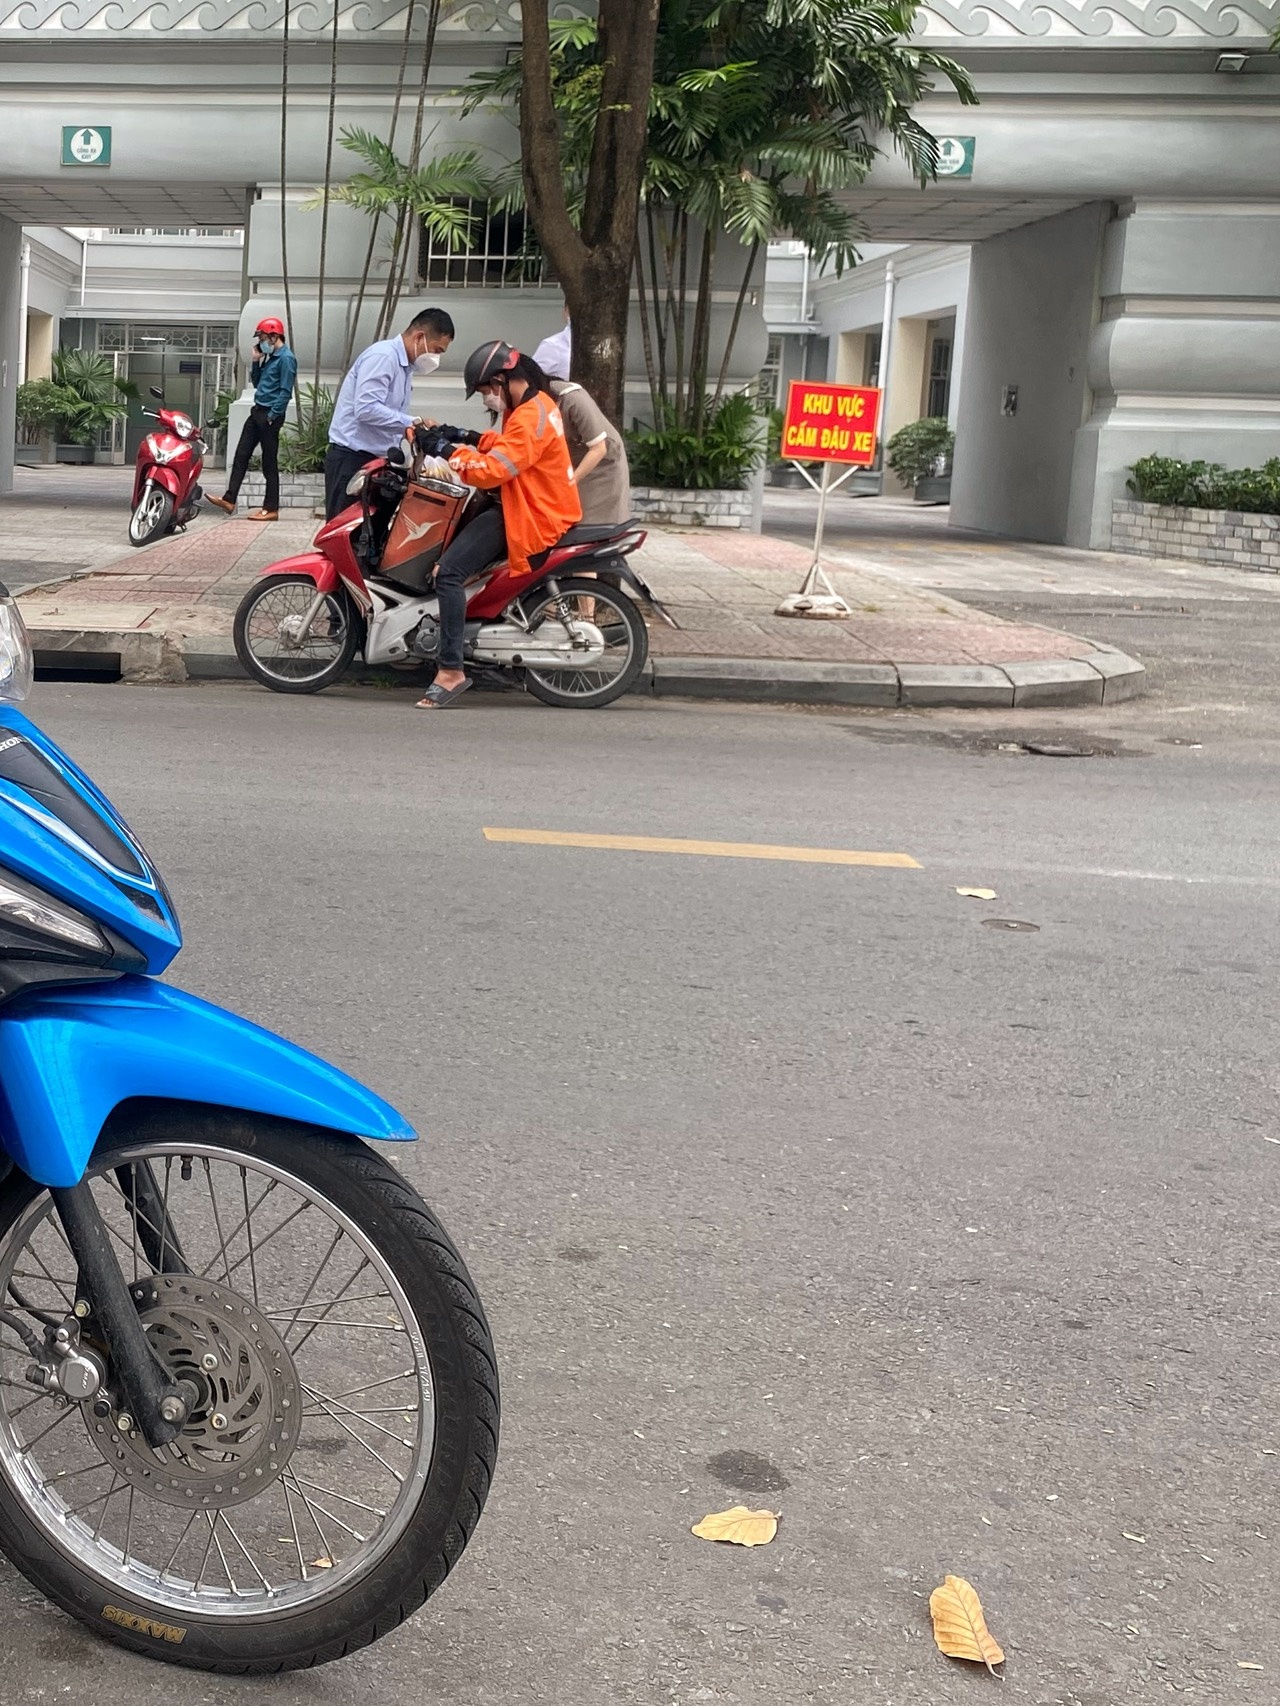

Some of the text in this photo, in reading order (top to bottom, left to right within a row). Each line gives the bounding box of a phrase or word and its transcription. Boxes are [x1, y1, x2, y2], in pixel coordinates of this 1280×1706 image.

[803, 393, 865, 423] KHU VỰC
[852, 431, 873, 453] XE
[100, 1604, 188, 1645] MAXXIS
